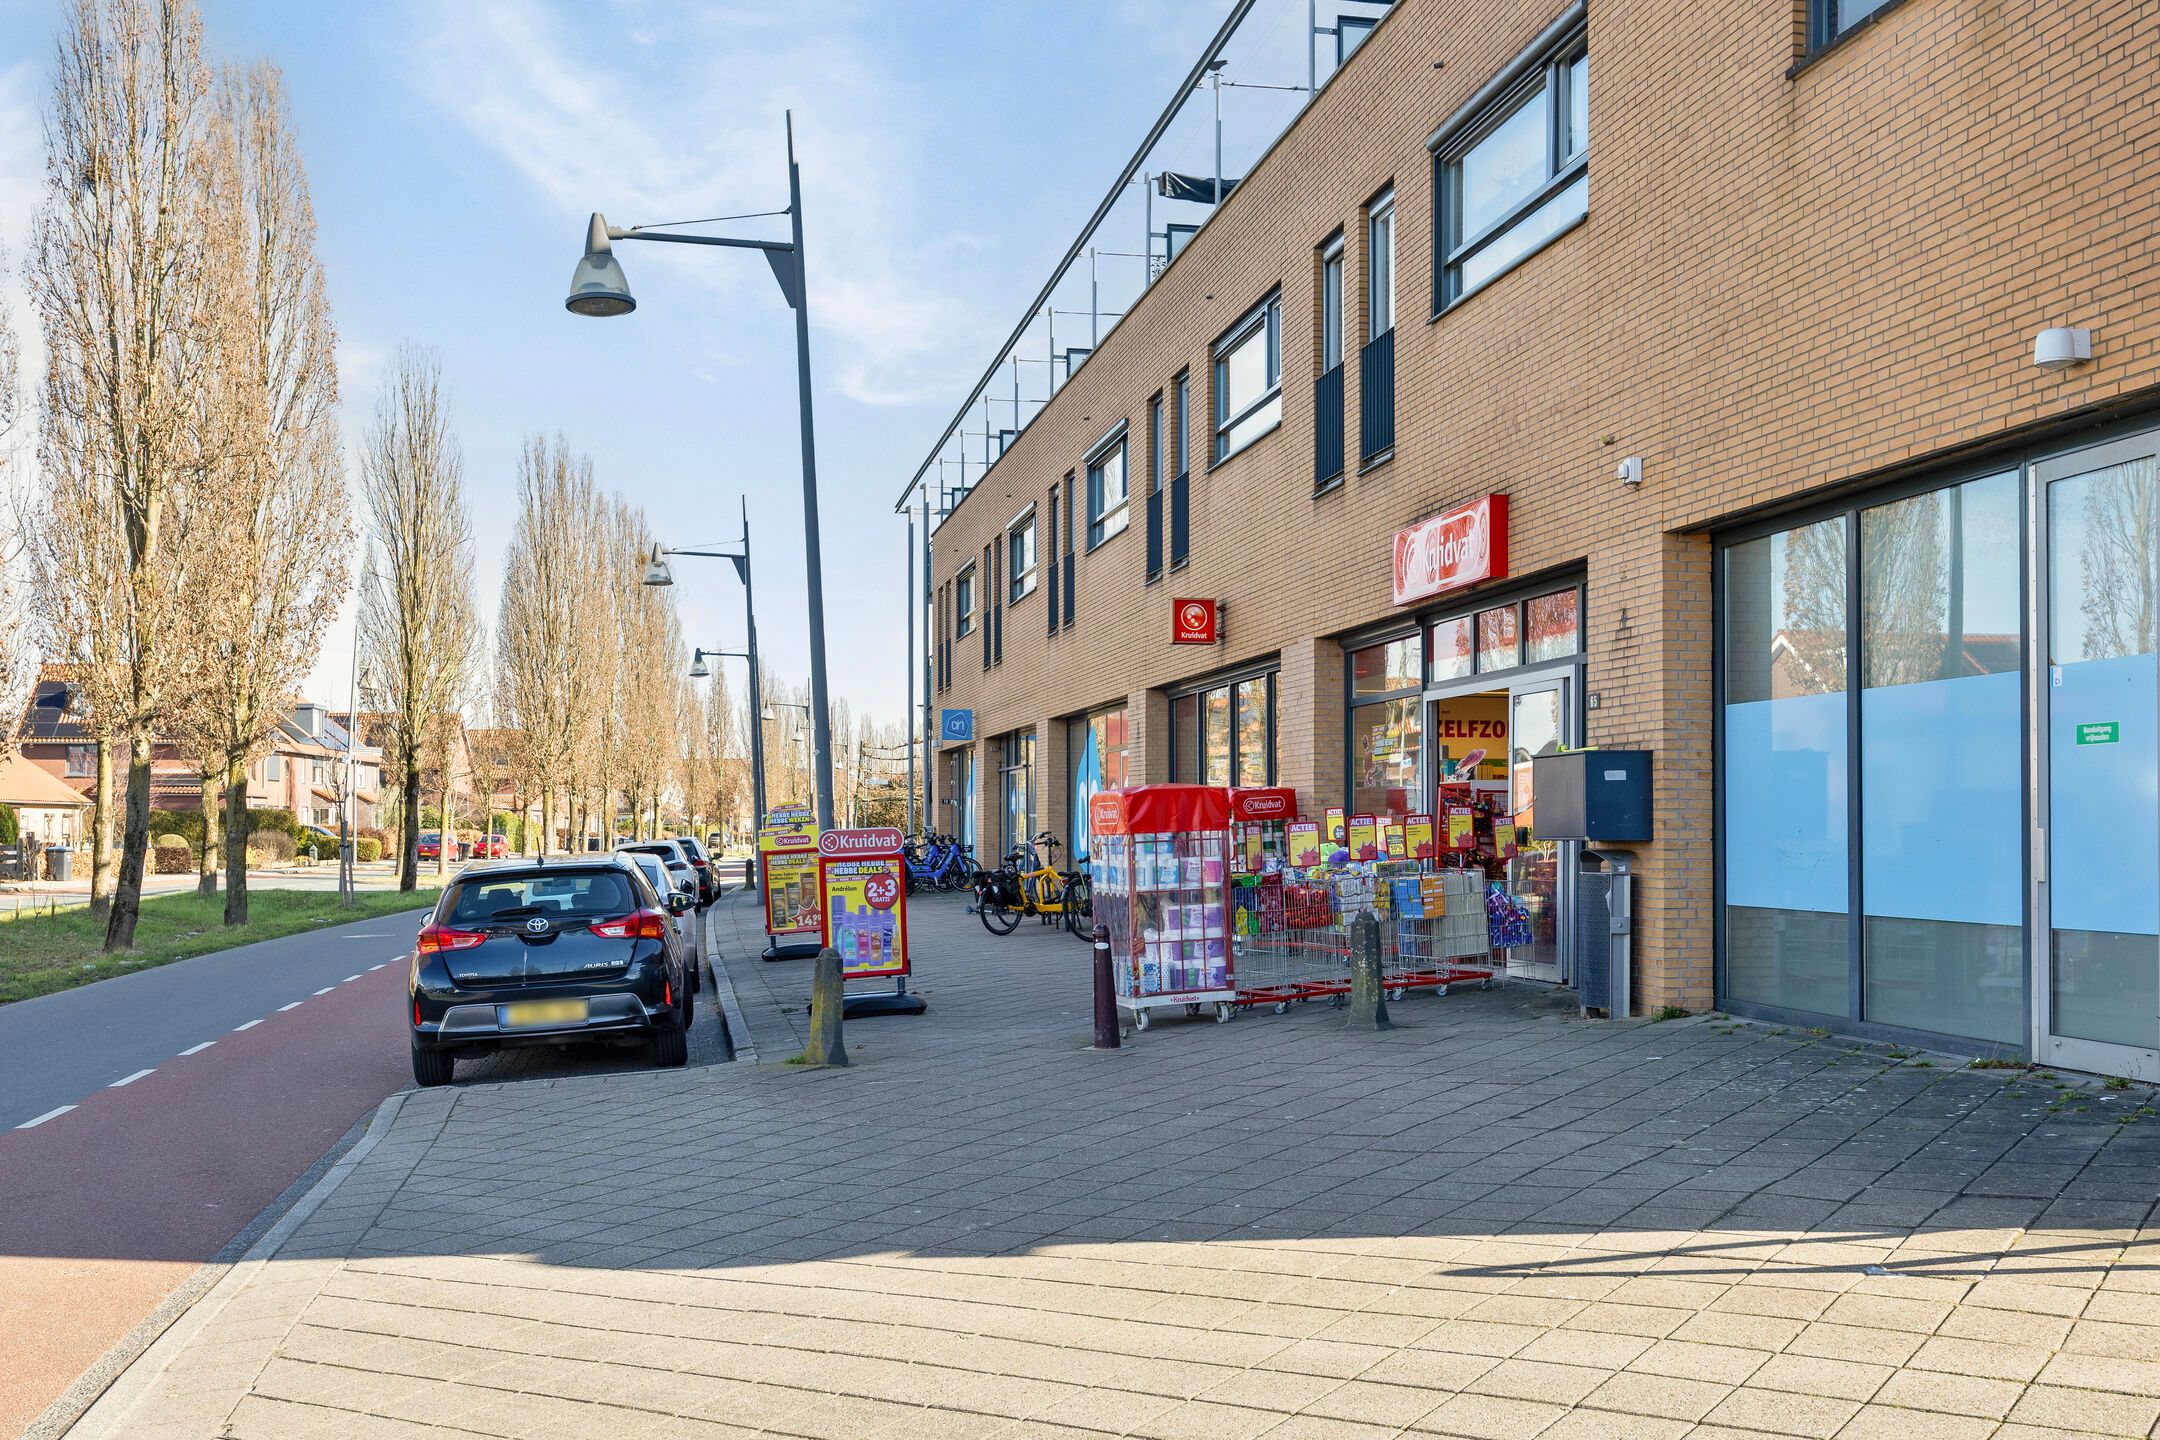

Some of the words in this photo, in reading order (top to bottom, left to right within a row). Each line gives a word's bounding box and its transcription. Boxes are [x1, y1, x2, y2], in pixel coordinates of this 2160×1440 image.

[1255, 800, 1281, 809] Kruidvat
[1350, 818, 1374, 826] ACTIE!
[1407, 816, 1430, 824] ACTIE!
[1291, 823, 1316, 831] ACTIE!
[783, 837, 809, 845] Kruidvat
[840, 833, 897, 849] Kruidvat
[858, 866, 883, 874] DEALS
[867, 879, 896, 897] 2+3
